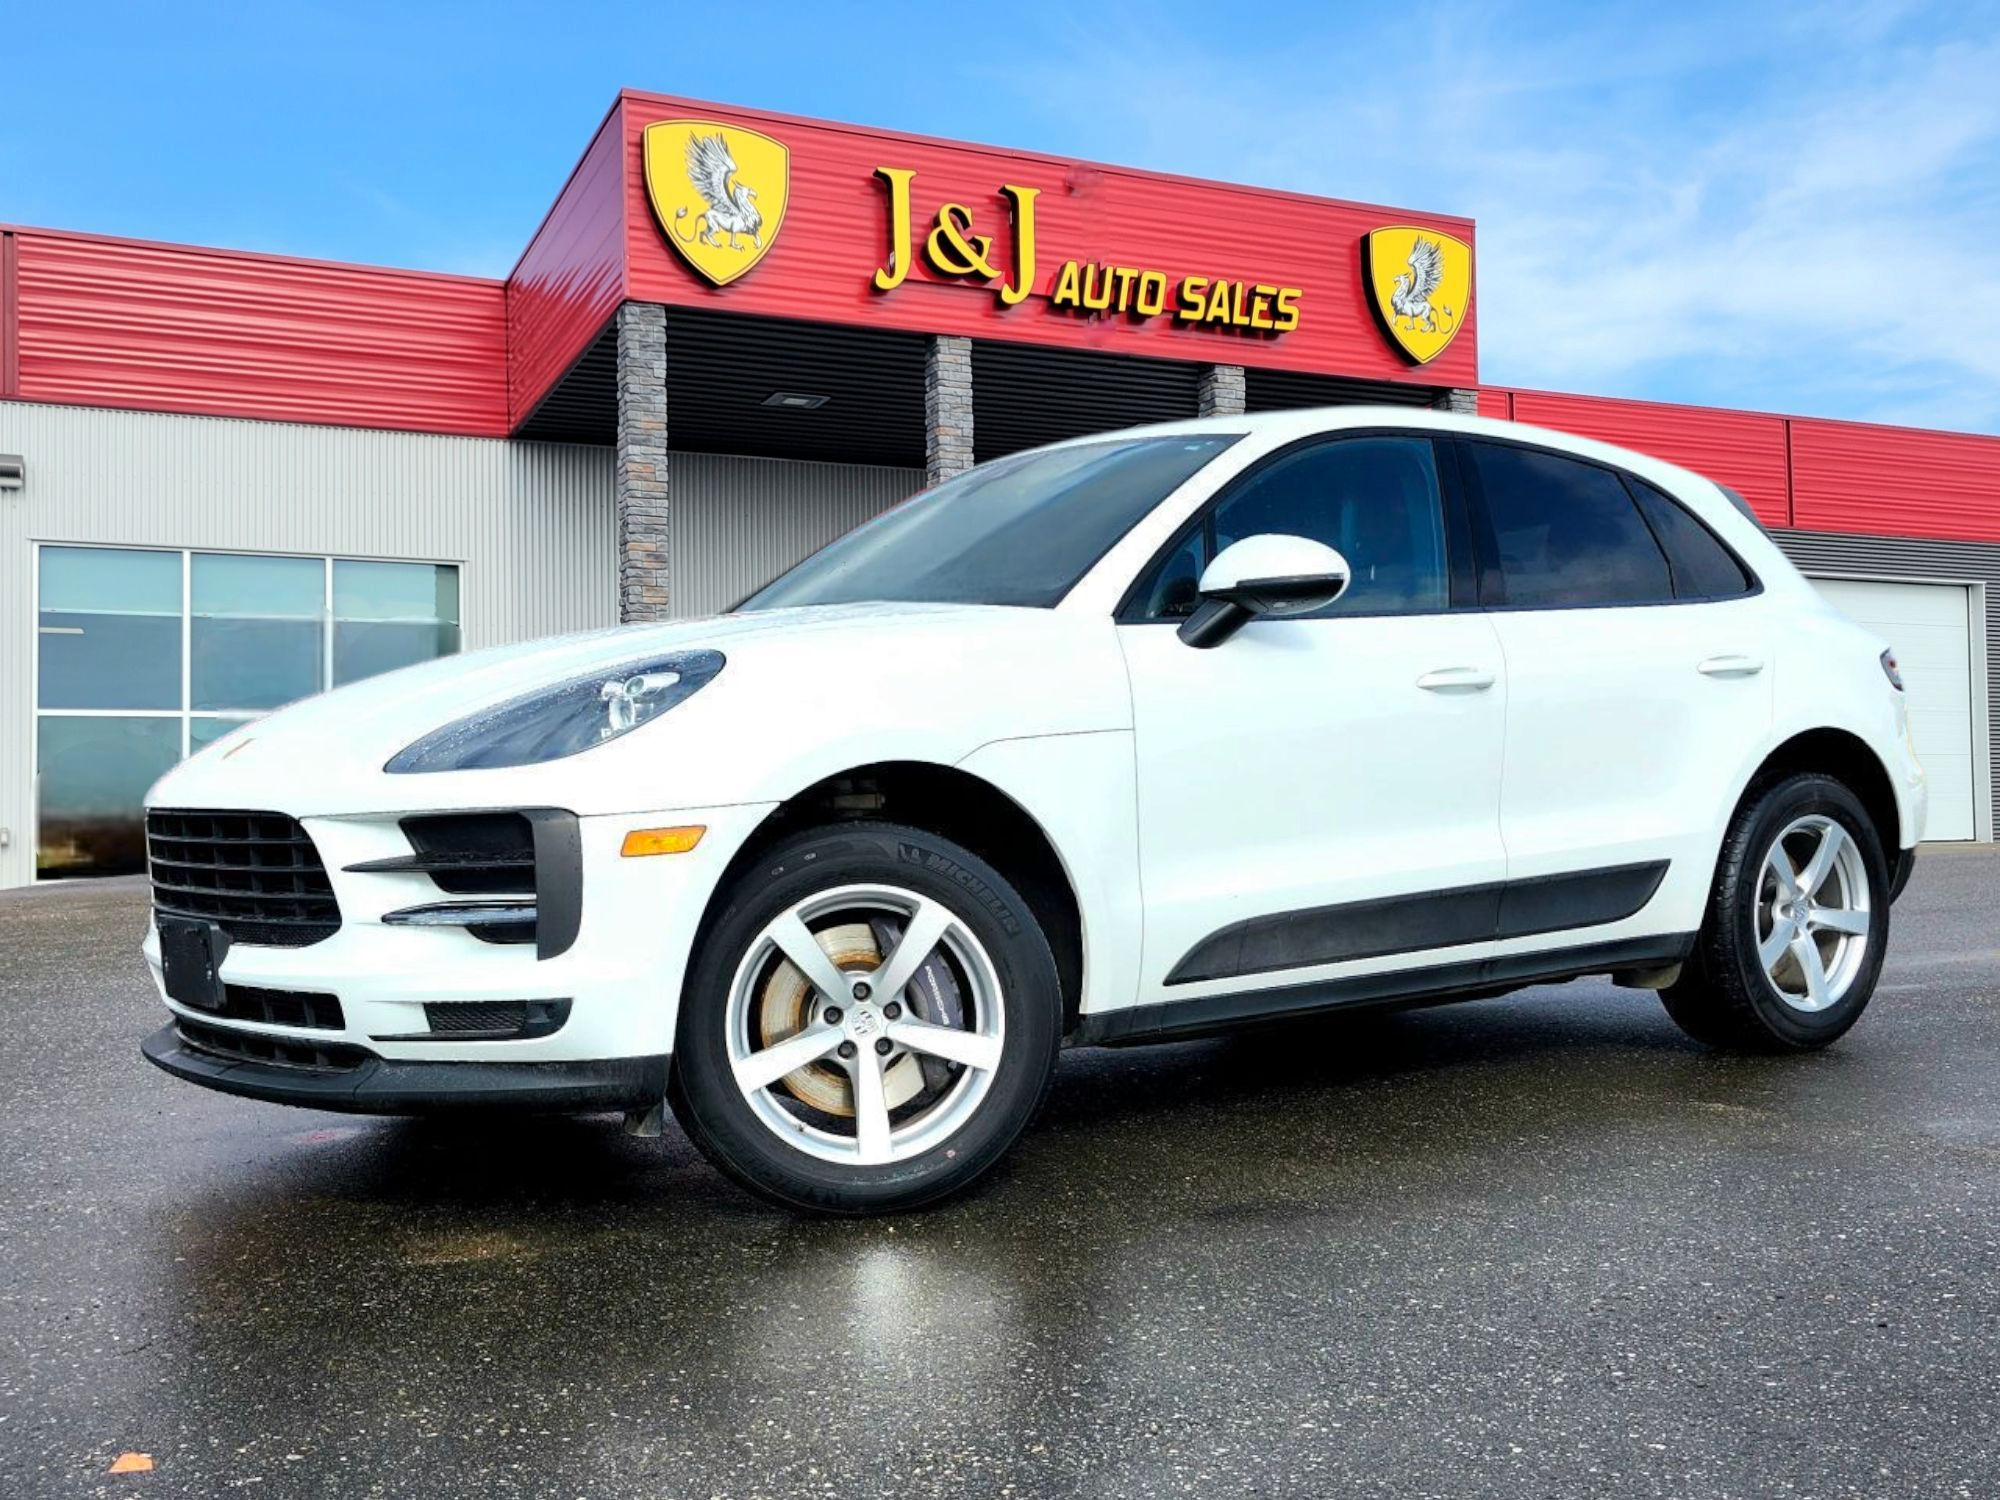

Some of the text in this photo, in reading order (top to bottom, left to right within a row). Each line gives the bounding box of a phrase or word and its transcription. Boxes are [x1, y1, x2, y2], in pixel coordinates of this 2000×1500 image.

[873, 165, 1303, 331] J&J AUTO SALES
[925, 853, 1020, 936] MICHELIN
